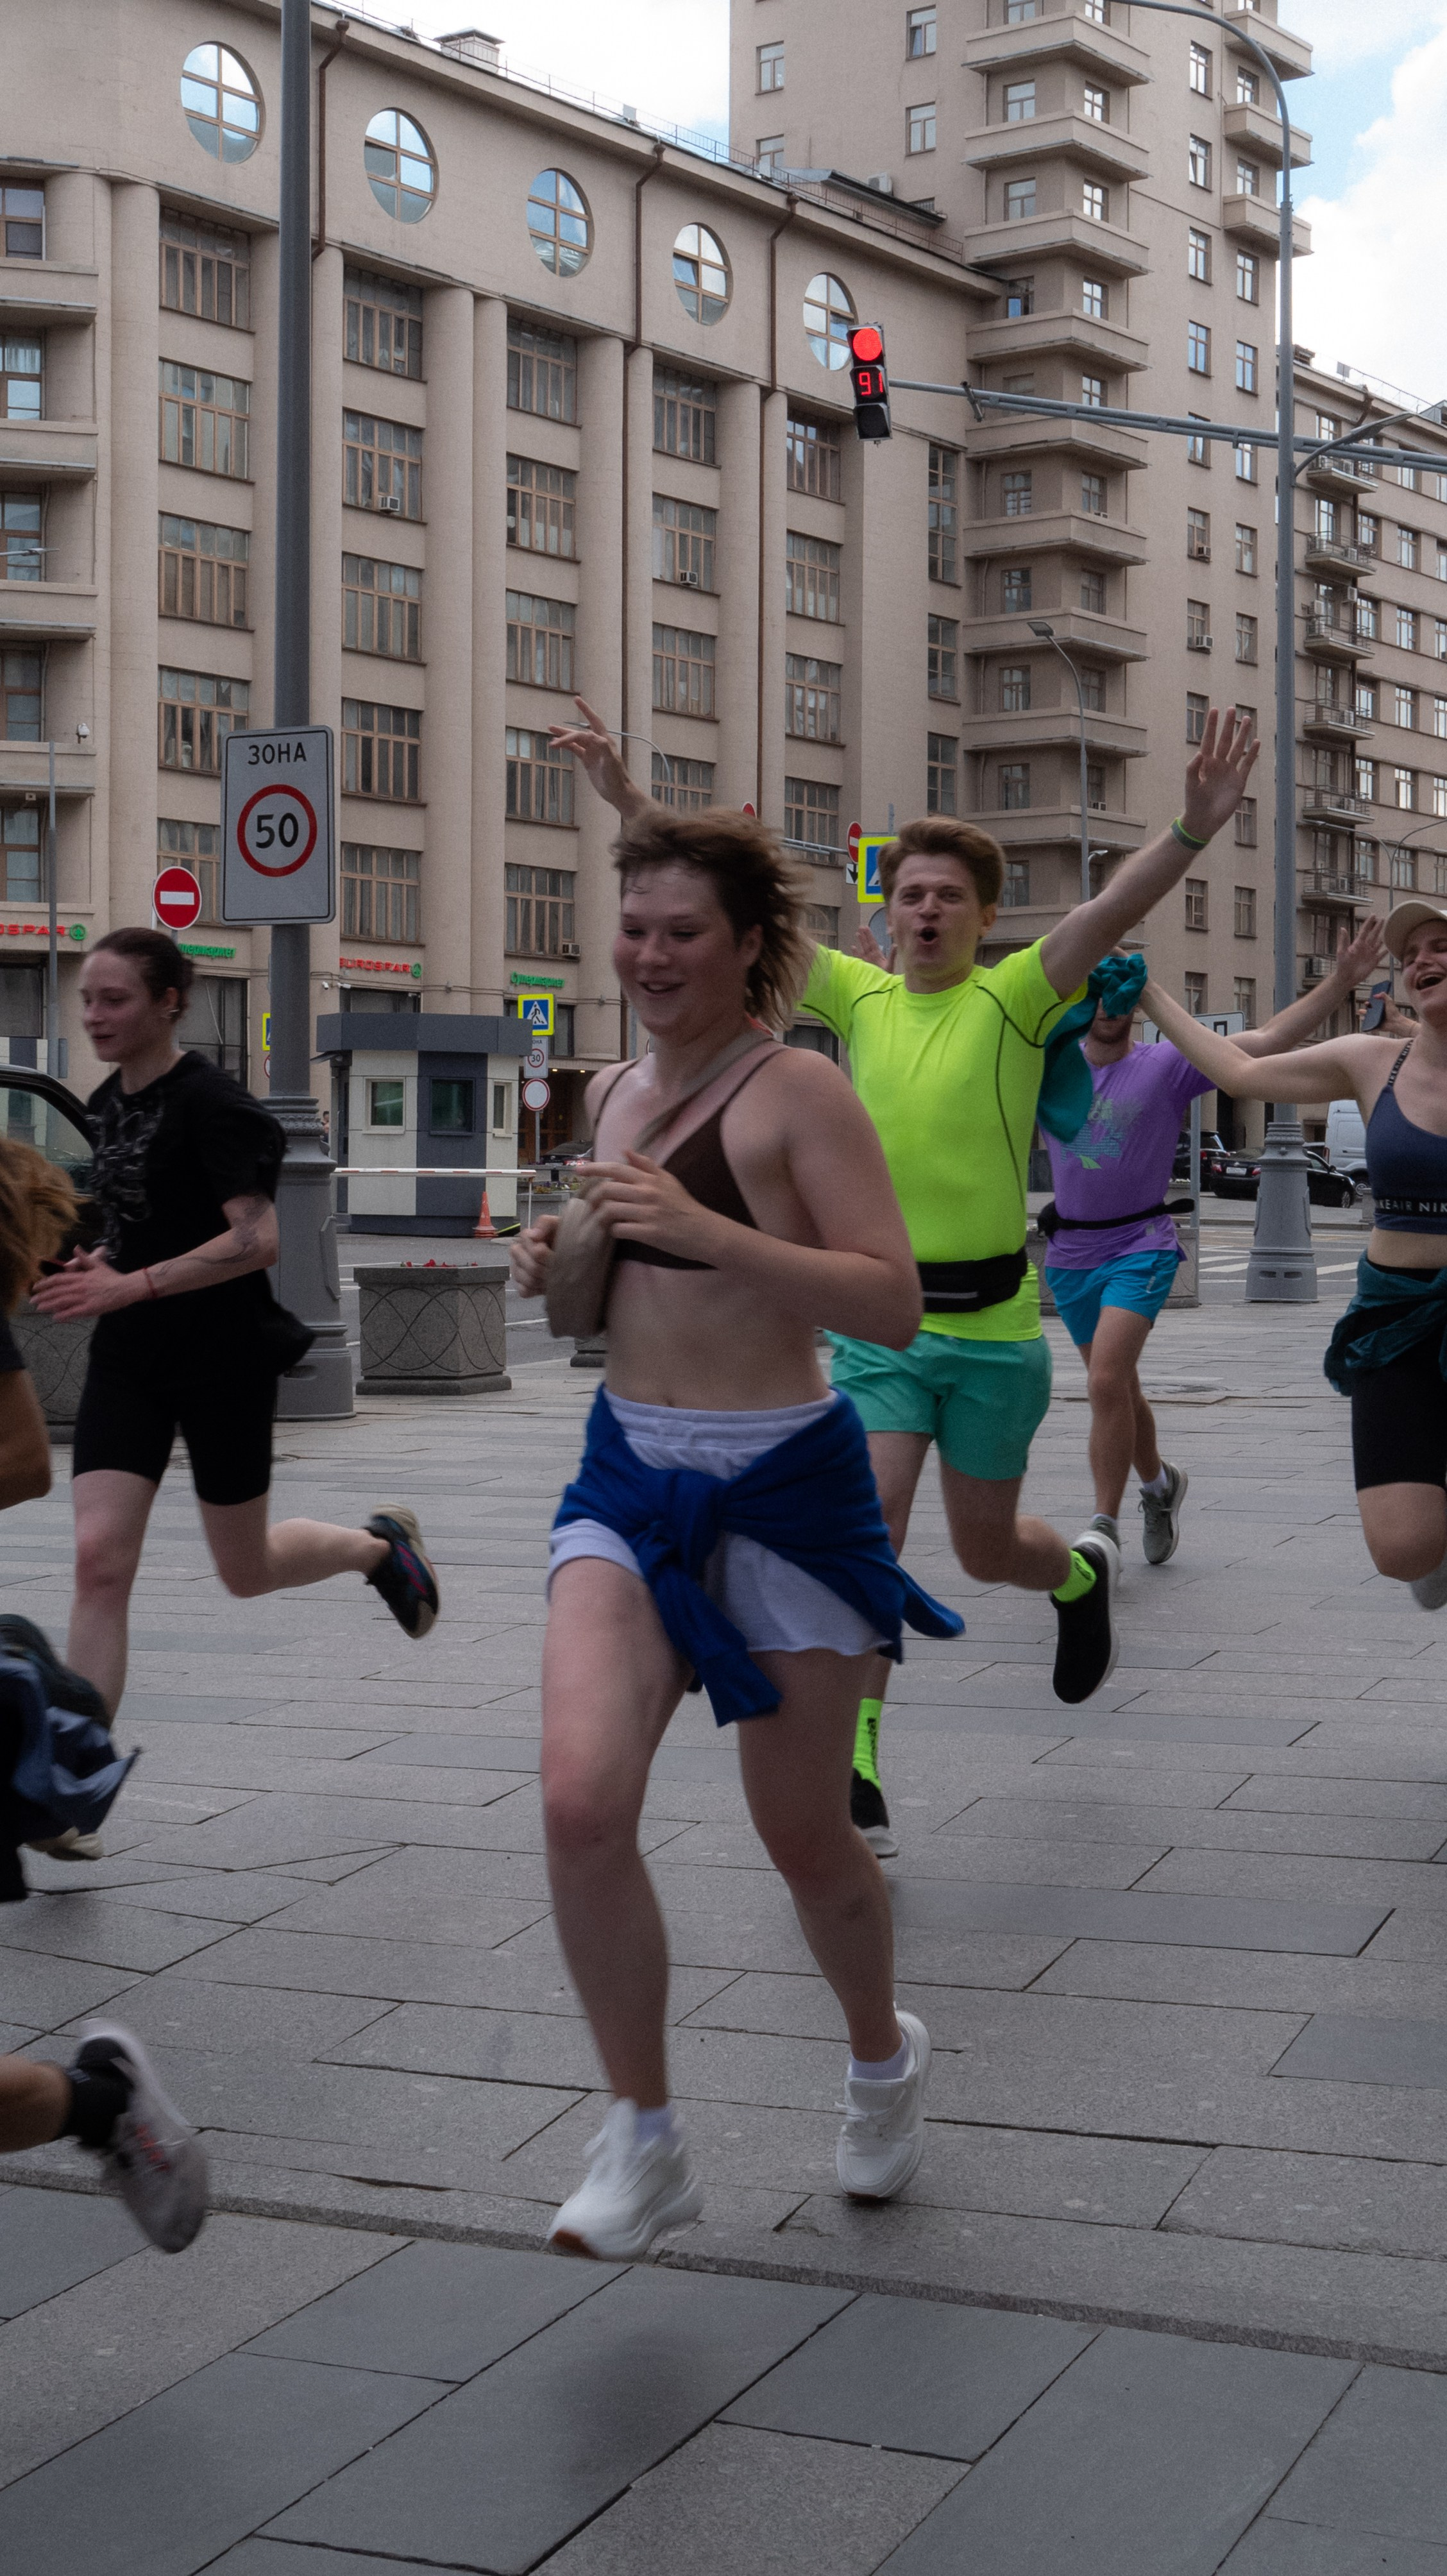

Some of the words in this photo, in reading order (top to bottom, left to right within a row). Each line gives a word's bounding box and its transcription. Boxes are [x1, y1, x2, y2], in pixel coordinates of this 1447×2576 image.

[858, 371, 884, 396] 91
[248, 742, 307, 765] ЗОНА
[255, 812, 299, 849] 50
[339, 956, 410, 972] EUROSPAR
